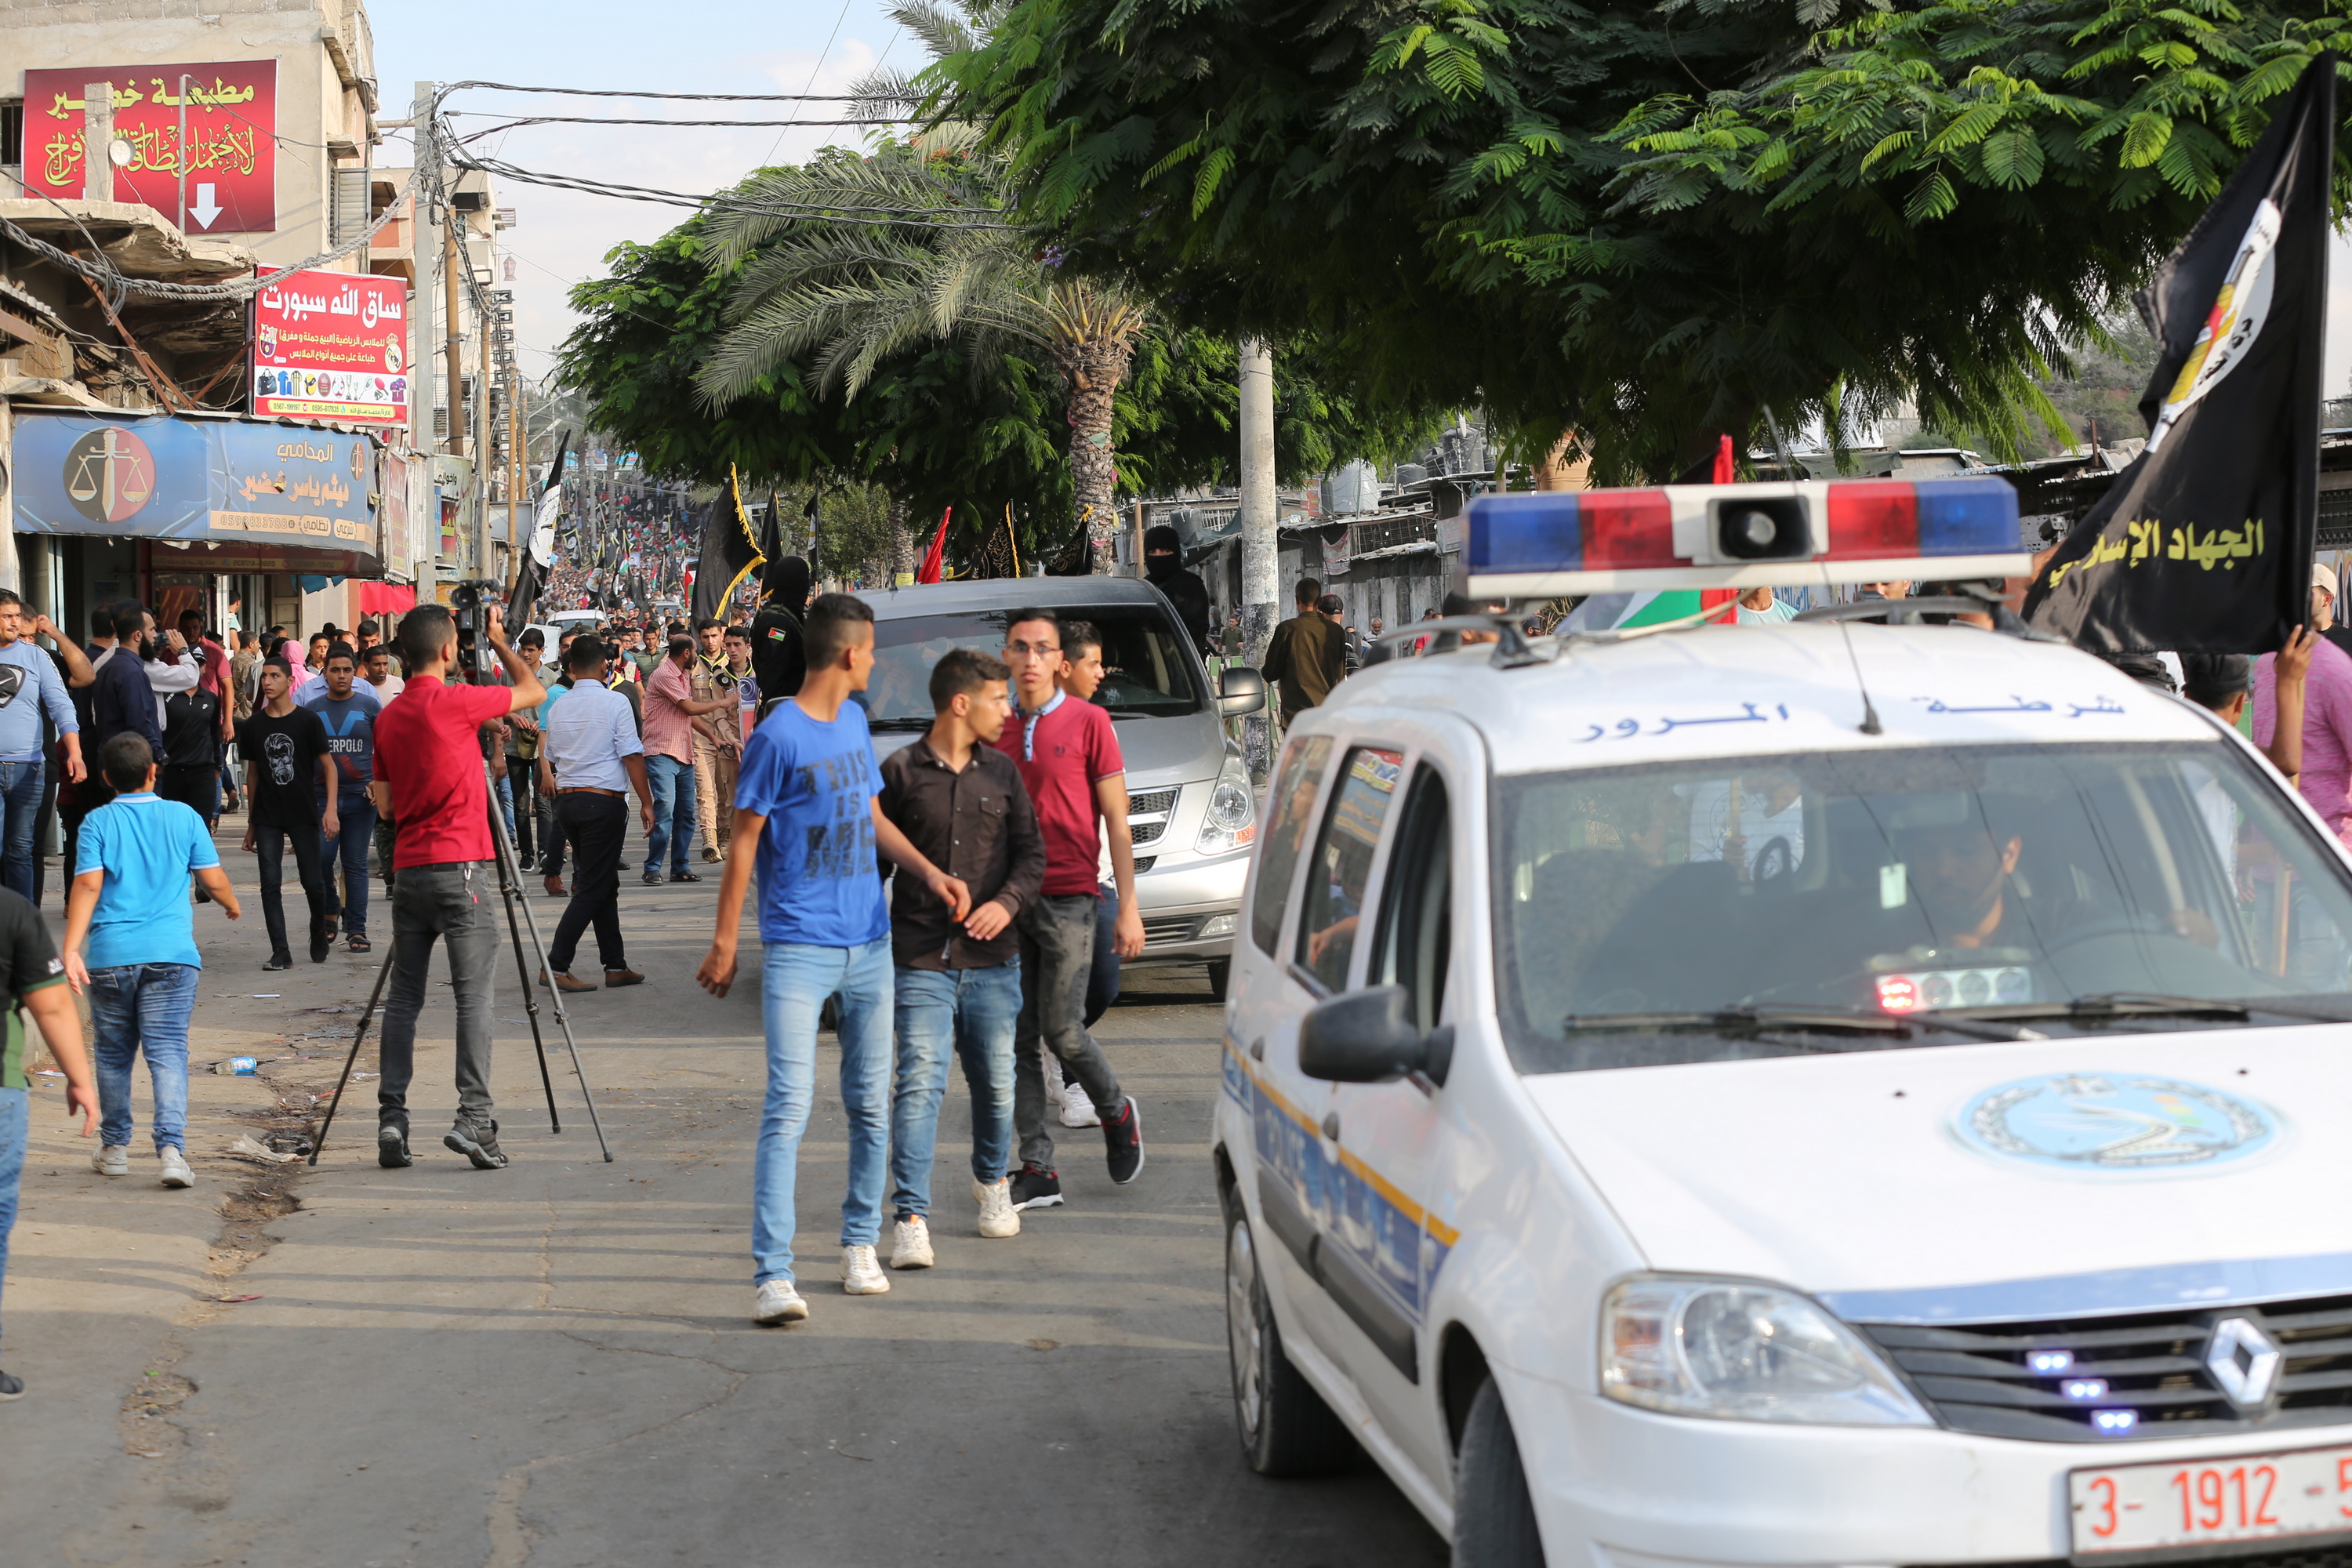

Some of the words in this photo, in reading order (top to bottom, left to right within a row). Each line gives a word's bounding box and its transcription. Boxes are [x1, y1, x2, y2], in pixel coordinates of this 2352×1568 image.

[151, 76, 256, 113] مطبعة
[262, 285, 327, 321] سبورت
[361, 290, 401, 328] ساق
[299, 333, 303, 343] و
[303, 332, 319, 344] جملة
[360, 338, 385, 348] للملابس
[289, 349, 315, 360] الملابس
[314, 348, 330, 361] أنواع
[329, 352, 346, 363] جميع
[345, 353, 357, 363] على
[357, 352, 376, 365] طباعة
[273, 402, 300, 411] 0567-199197
[276, 440, 334, 463] المحامي
[287, 474, 321, 507] ياسر
[303, 518, 329, 532] نظامي
[2049, 517, 2161, 588] الإسلاي
[2168, 517, 2264, 571] الجهاد
[1910, 693, 2126, 718] شرطة
[1568, 702, 1788, 742] المرور
[796, 749, 869, 797] THIS
[836, 791, 860, 818] IS
[2170, 1462, 2280, 1533] 1912
